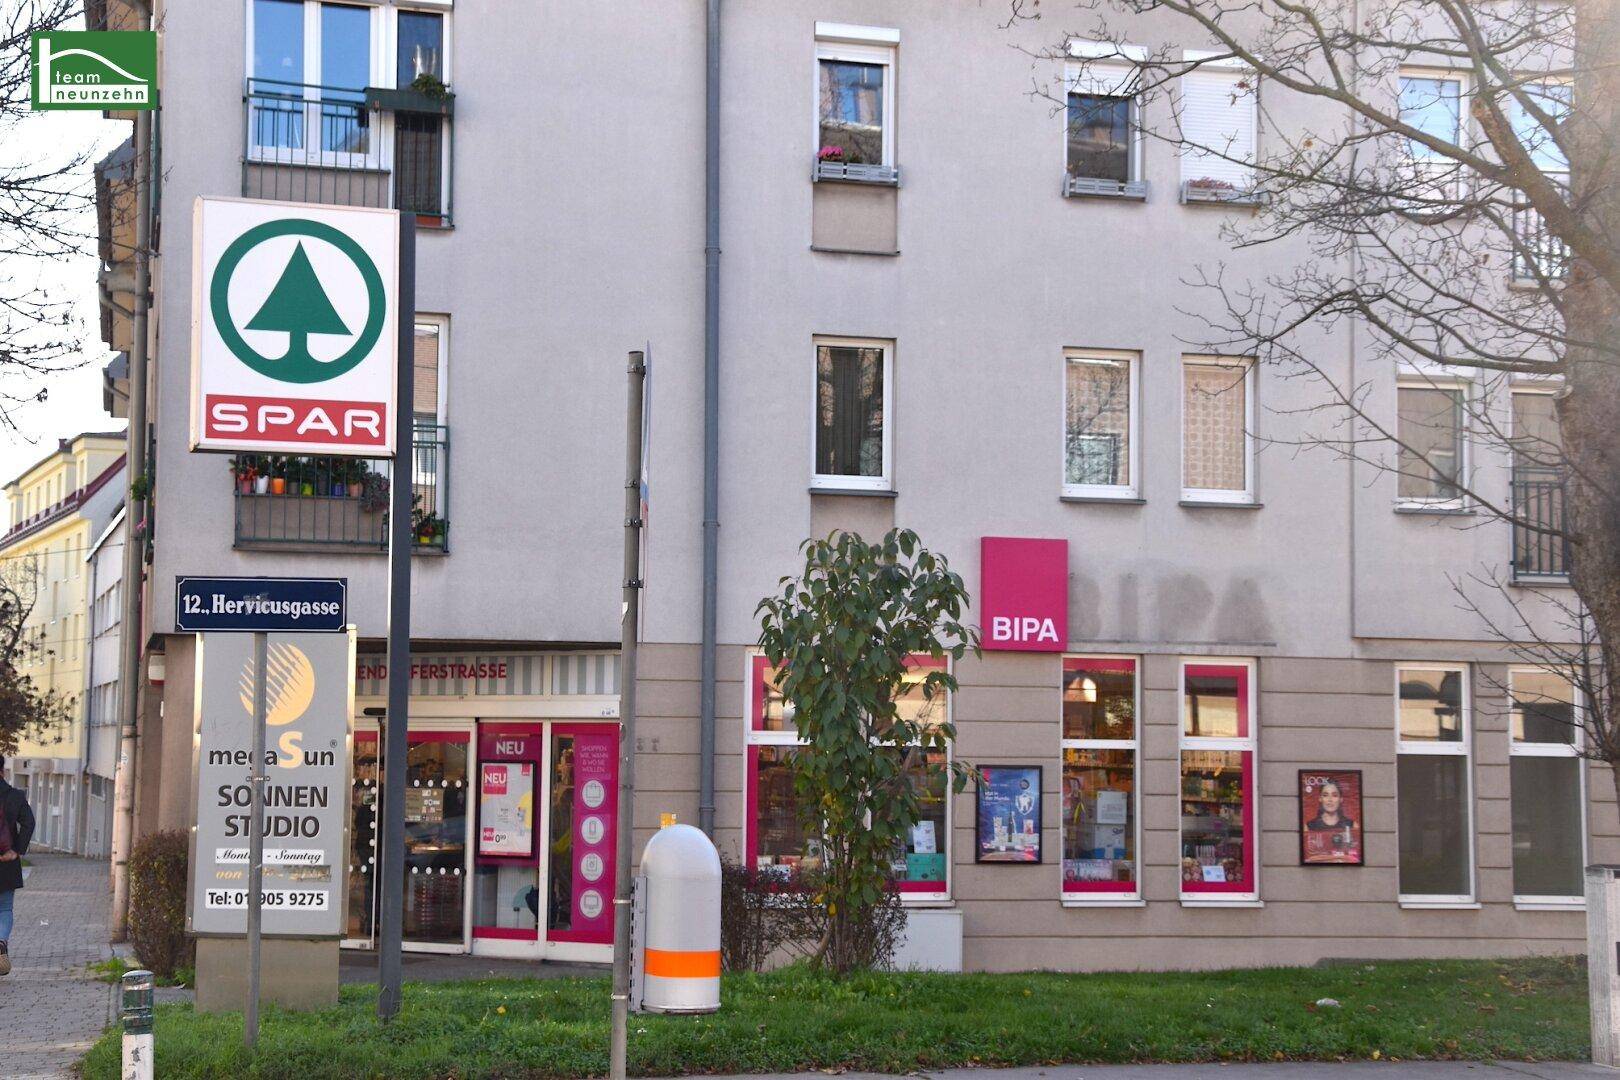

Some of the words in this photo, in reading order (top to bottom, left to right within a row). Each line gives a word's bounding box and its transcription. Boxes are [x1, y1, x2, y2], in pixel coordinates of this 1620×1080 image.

[212, 403, 380, 438] SPAR
[993, 616, 1059, 642] BIPA
[496, 741, 524, 755] NEU
[484, 772, 506, 784] NEU
[275, 849, 321, 864] Sonntag
[209, 892, 231, 905] Tel:
[289, 893, 324, 906] 9275
